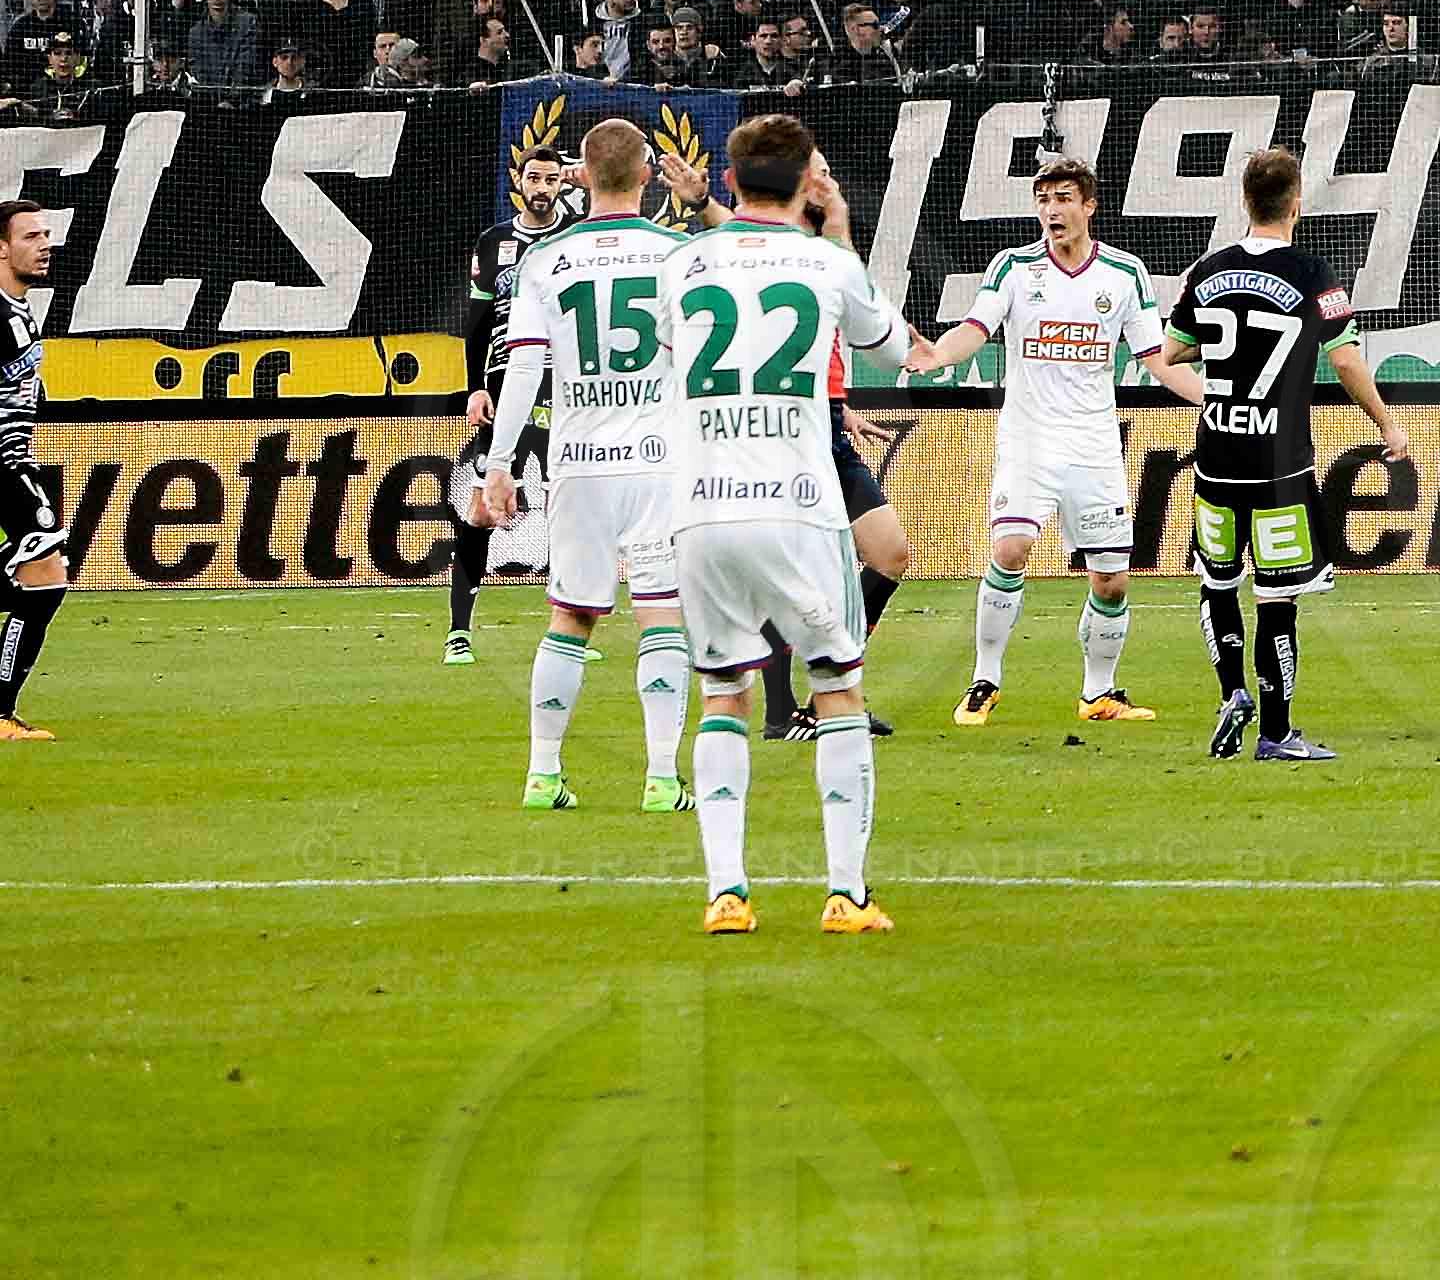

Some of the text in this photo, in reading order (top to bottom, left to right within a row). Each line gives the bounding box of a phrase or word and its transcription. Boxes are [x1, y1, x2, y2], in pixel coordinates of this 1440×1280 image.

[1197, 269, 1300, 309] PUNTIGAMER
[558, 278, 659, 376] 15
[677, 283, 822, 401] 22
[1039, 322, 1098, 340] WIEN
[1024, 342, 1112, 360] ENERGIE
[1193, 306, 1303, 398] 27
[699, 405, 801, 442] PAVELIC
[1200, 401, 1278, 437] KLEM
[560, 440, 635, 462] Allianz
[691, 478, 785, 502] Allianz
[1256, 511, 1305, 562] E
